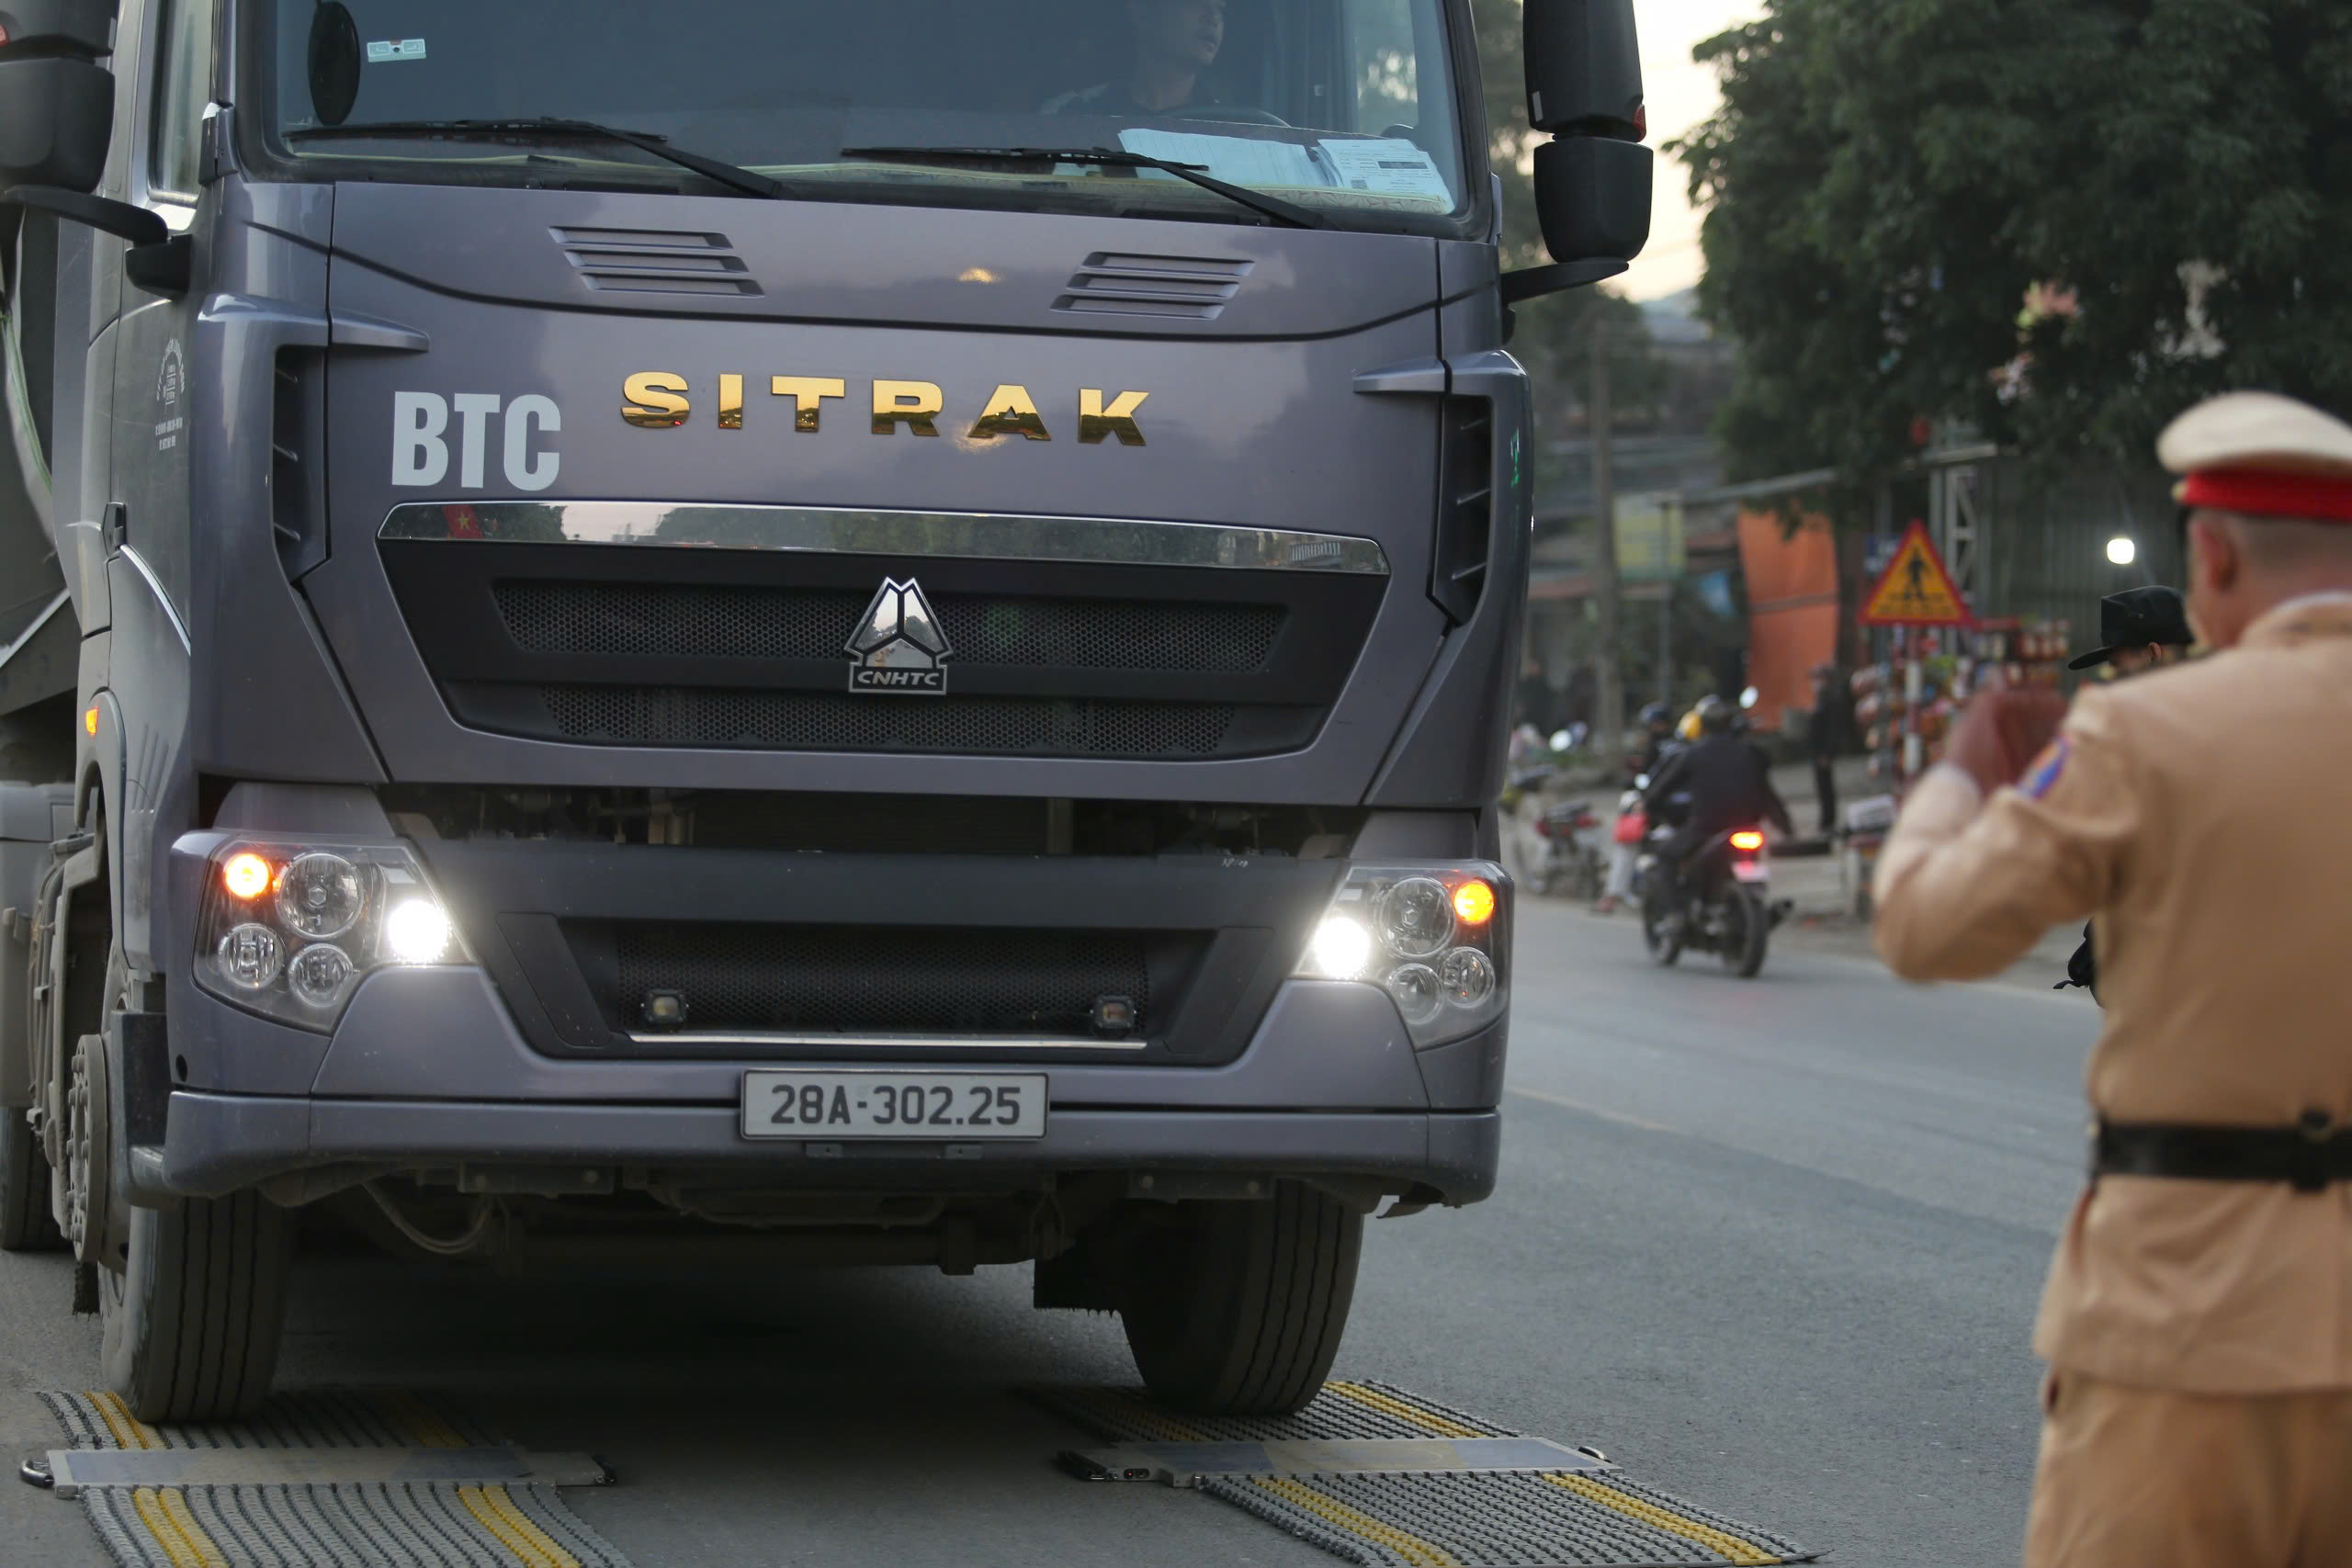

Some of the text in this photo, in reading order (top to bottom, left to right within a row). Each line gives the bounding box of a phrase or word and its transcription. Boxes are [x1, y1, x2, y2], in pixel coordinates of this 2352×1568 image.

[619, 371, 1150, 447] SITRAK
[390, 390, 561, 491] BTC
[857, 671, 939, 685] CNHTC
[771, 1084, 1021, 1125] 28A-302.25
